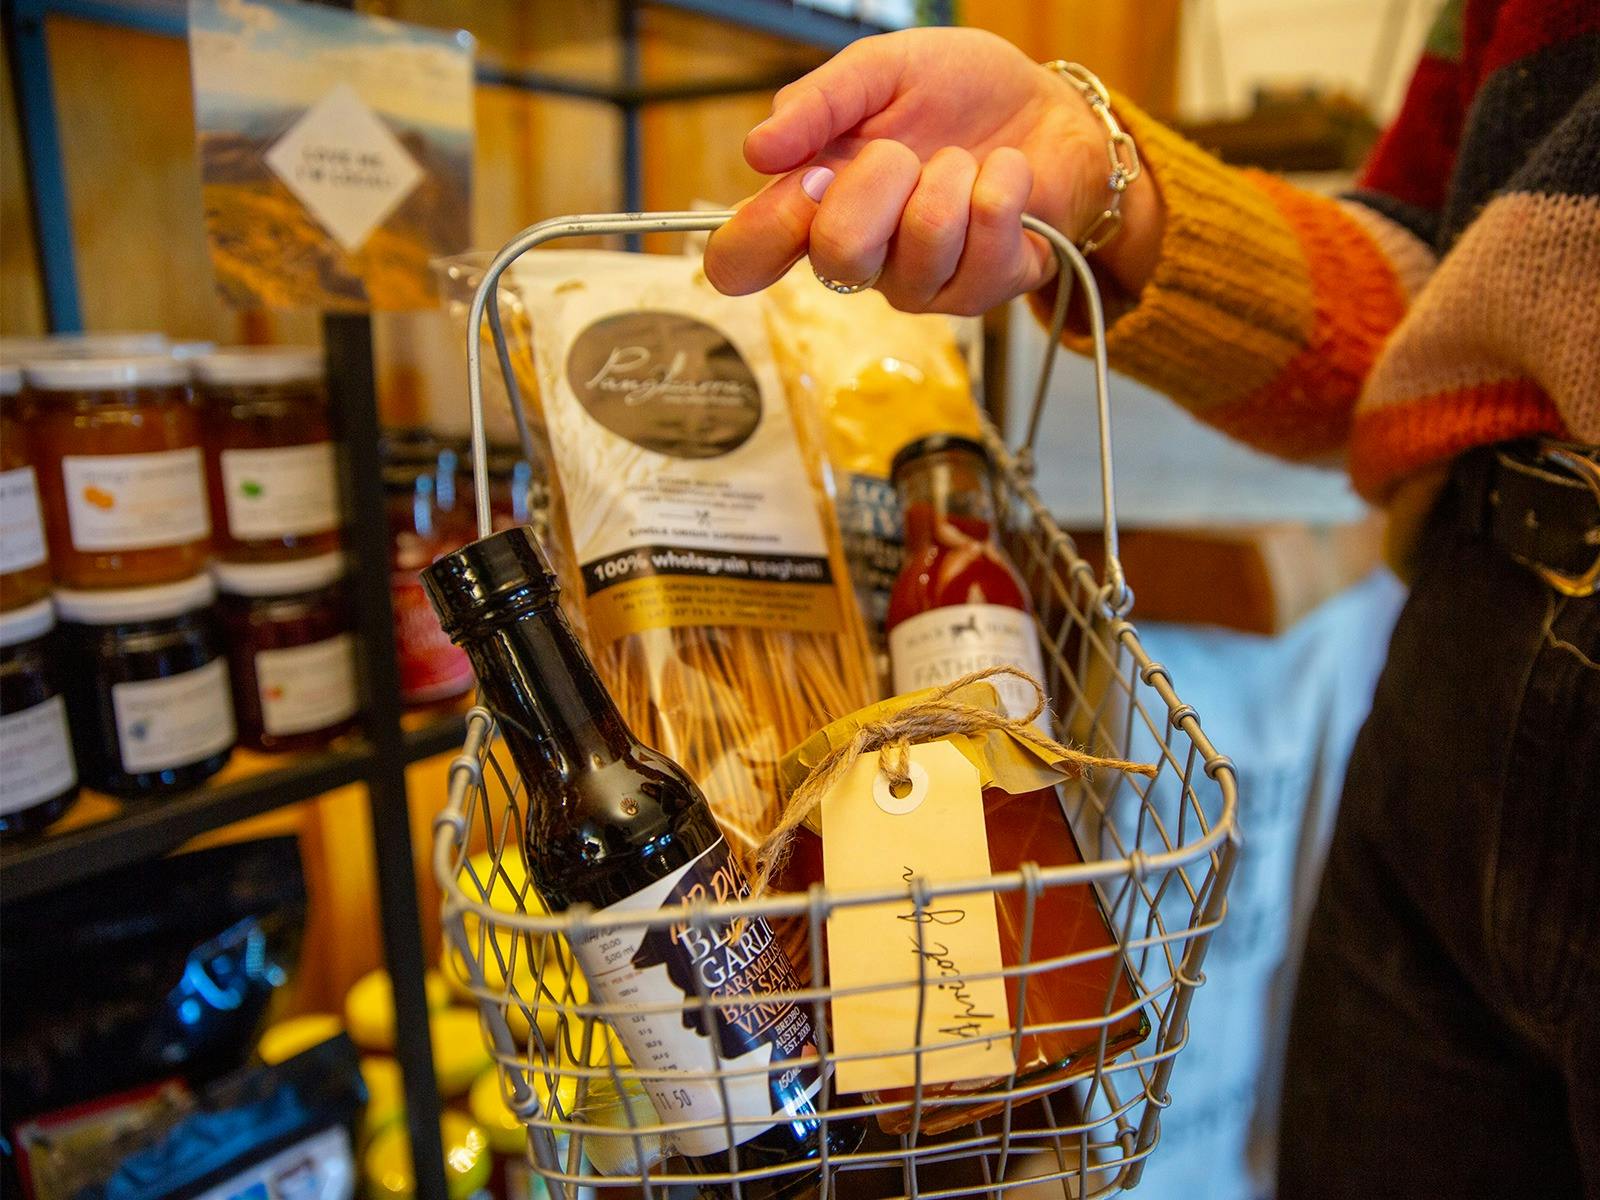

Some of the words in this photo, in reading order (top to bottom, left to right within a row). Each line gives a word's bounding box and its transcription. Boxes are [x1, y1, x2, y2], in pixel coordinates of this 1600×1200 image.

[594, 553, 649, 582] 100%
[651, 551, 749, 575] wholegrain
[751, 559, 824, 581] spaghetti
[908, 936, 995, 1051] Apricot
[774, 1006, 801, 1036] BREDBO
[775, 1012, 808, 1050] AUSTRALIA
